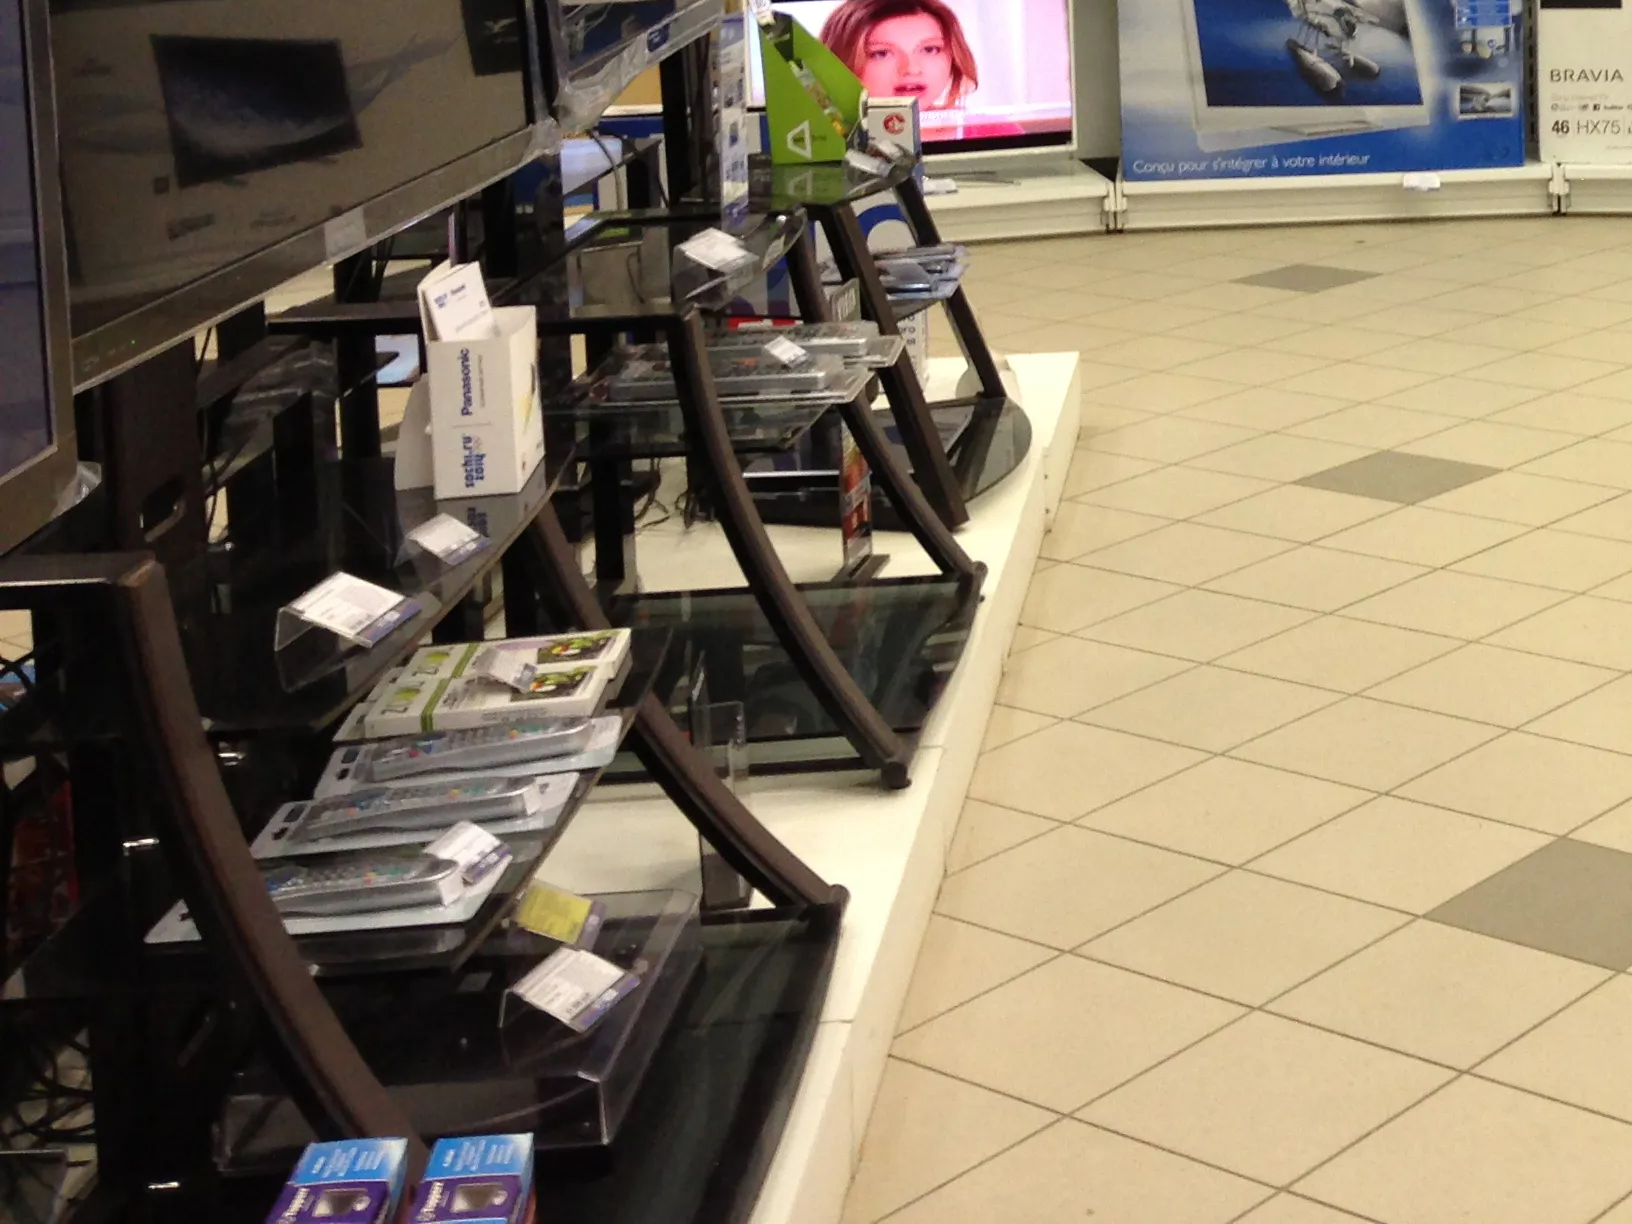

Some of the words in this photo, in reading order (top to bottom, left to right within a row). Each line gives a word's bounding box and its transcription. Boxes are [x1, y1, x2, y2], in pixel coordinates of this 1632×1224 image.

[1549, 68, 1624, 83] BRAVIA
[1551, 119, 1570, 135] 46
[1132, 159, 1175, 175] Conçu
[1178, 160, 1208, 175] pour
[1271, 154, 1279, 170] à
[1283, 155, 1316, 169] votre
[1319, 151, 1371, 166] intérieur
[458, 348, 473, 417] Panasonic
